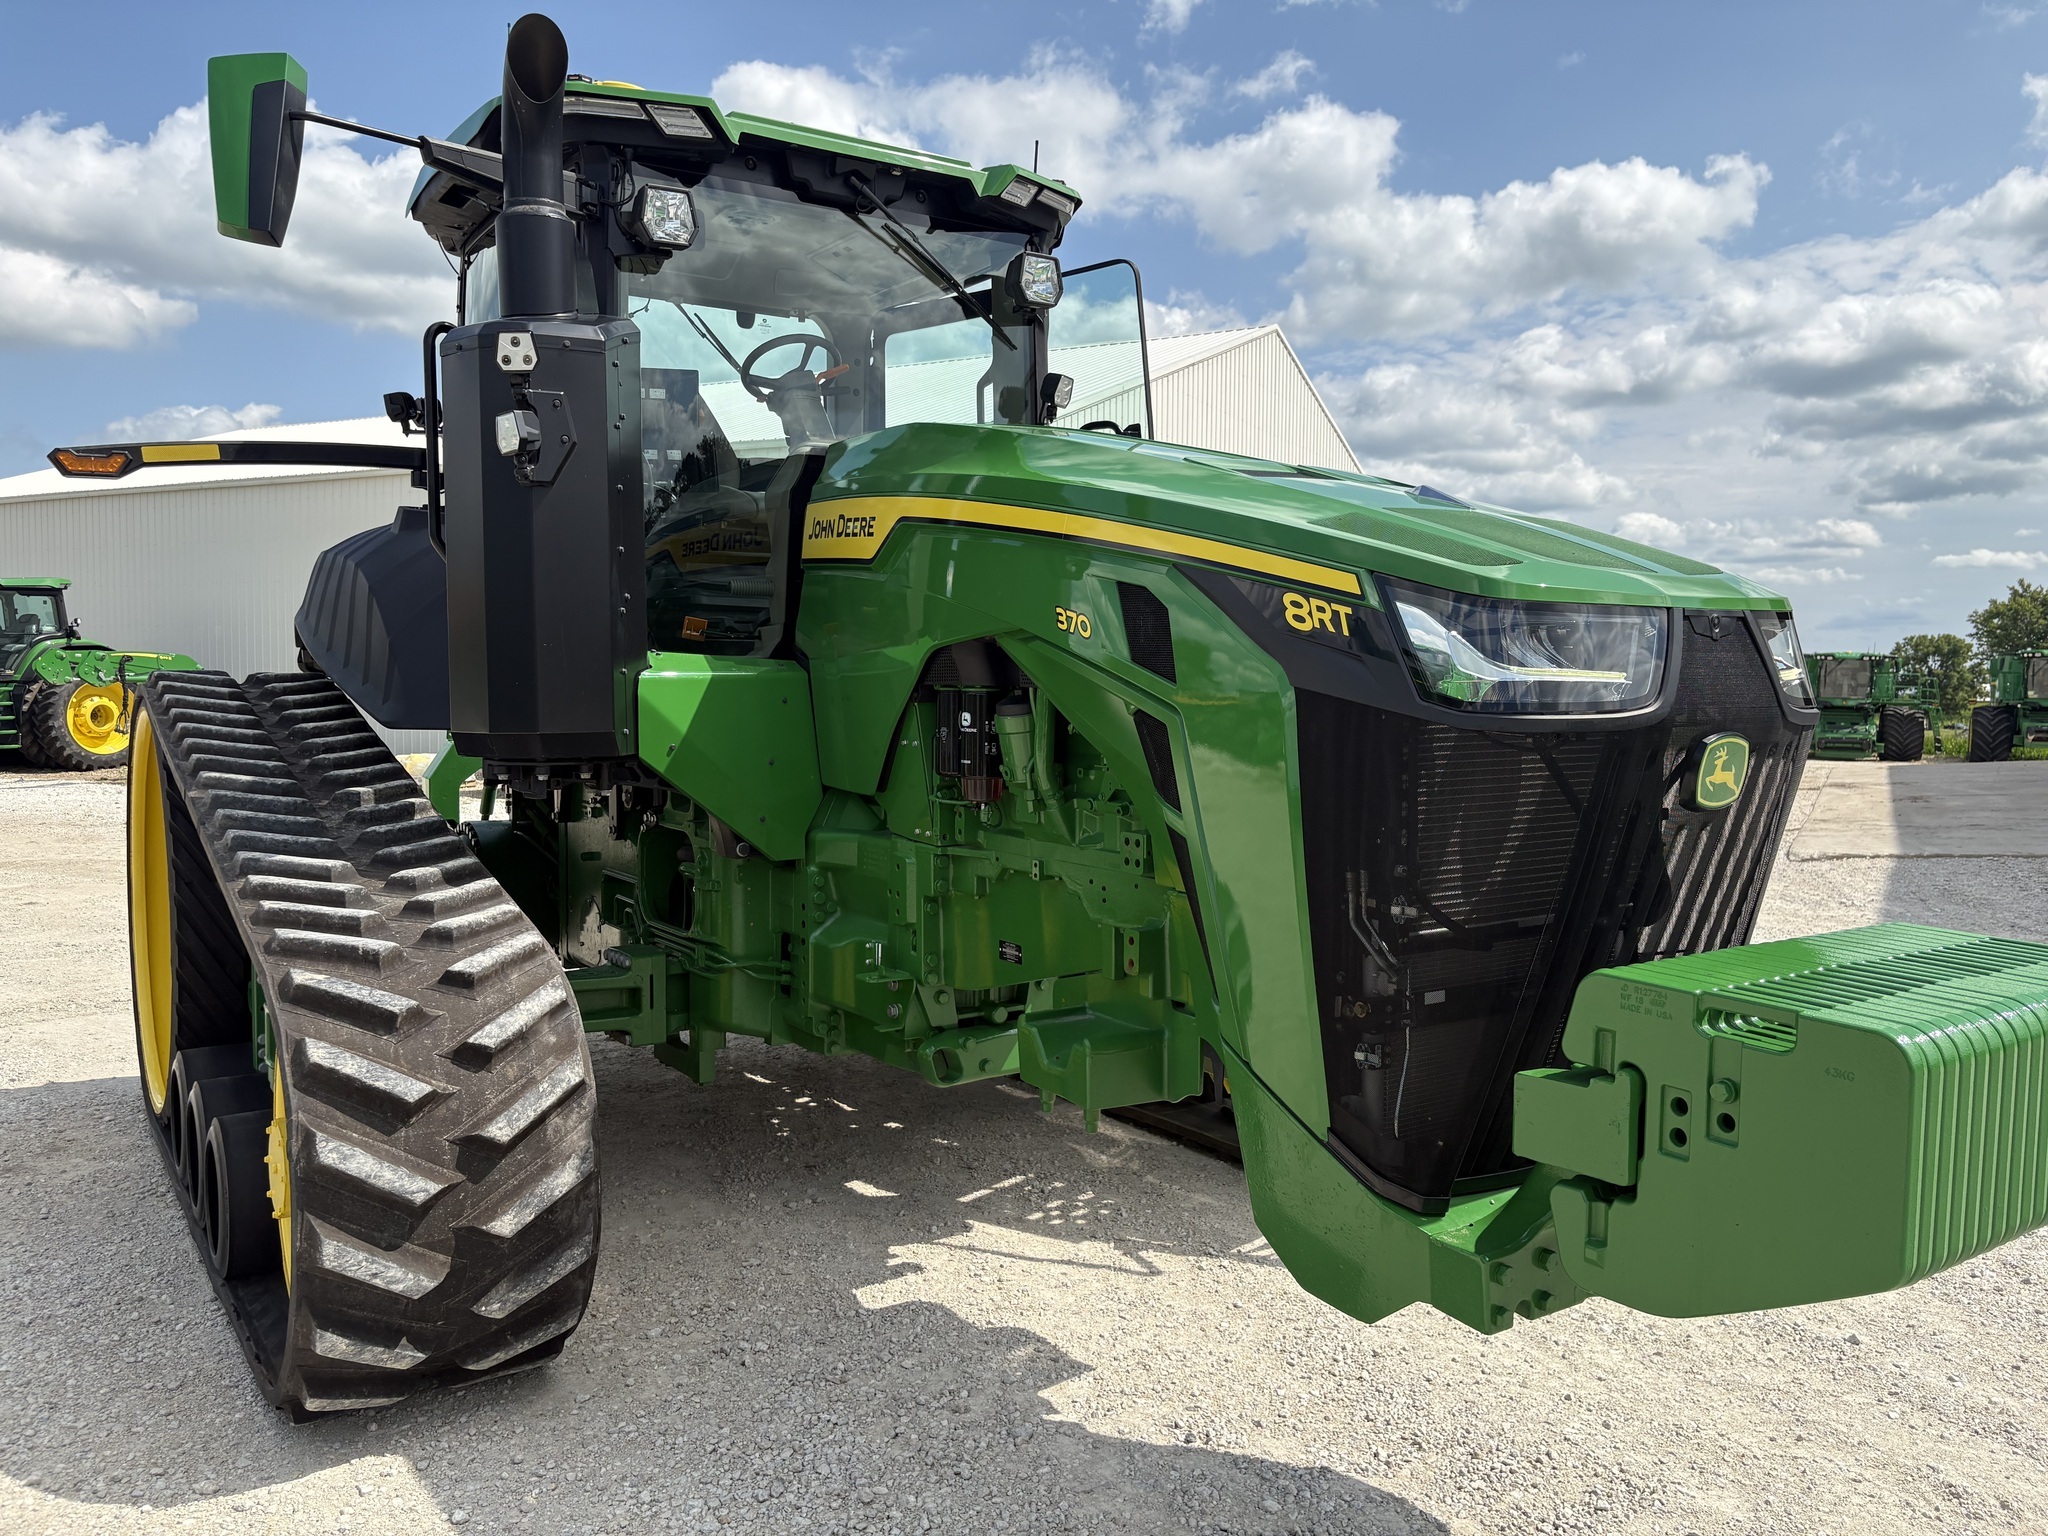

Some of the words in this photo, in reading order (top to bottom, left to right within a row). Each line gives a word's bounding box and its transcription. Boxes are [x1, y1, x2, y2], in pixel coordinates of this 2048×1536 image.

[808, 516, 835, 540] JOHN
[836, 514, 876, 538] DEERE
[1055, 606, 1092, 639] 370
[1282, 592, 1353, 637] 8RT
[1620, 1002, 1642, 1014] MADE
[1644, 1007, 1653, 1016] IN
[1656, 1010, 1673, 1021] USA
[1824, 1066, 1855, 1082] 43KG
